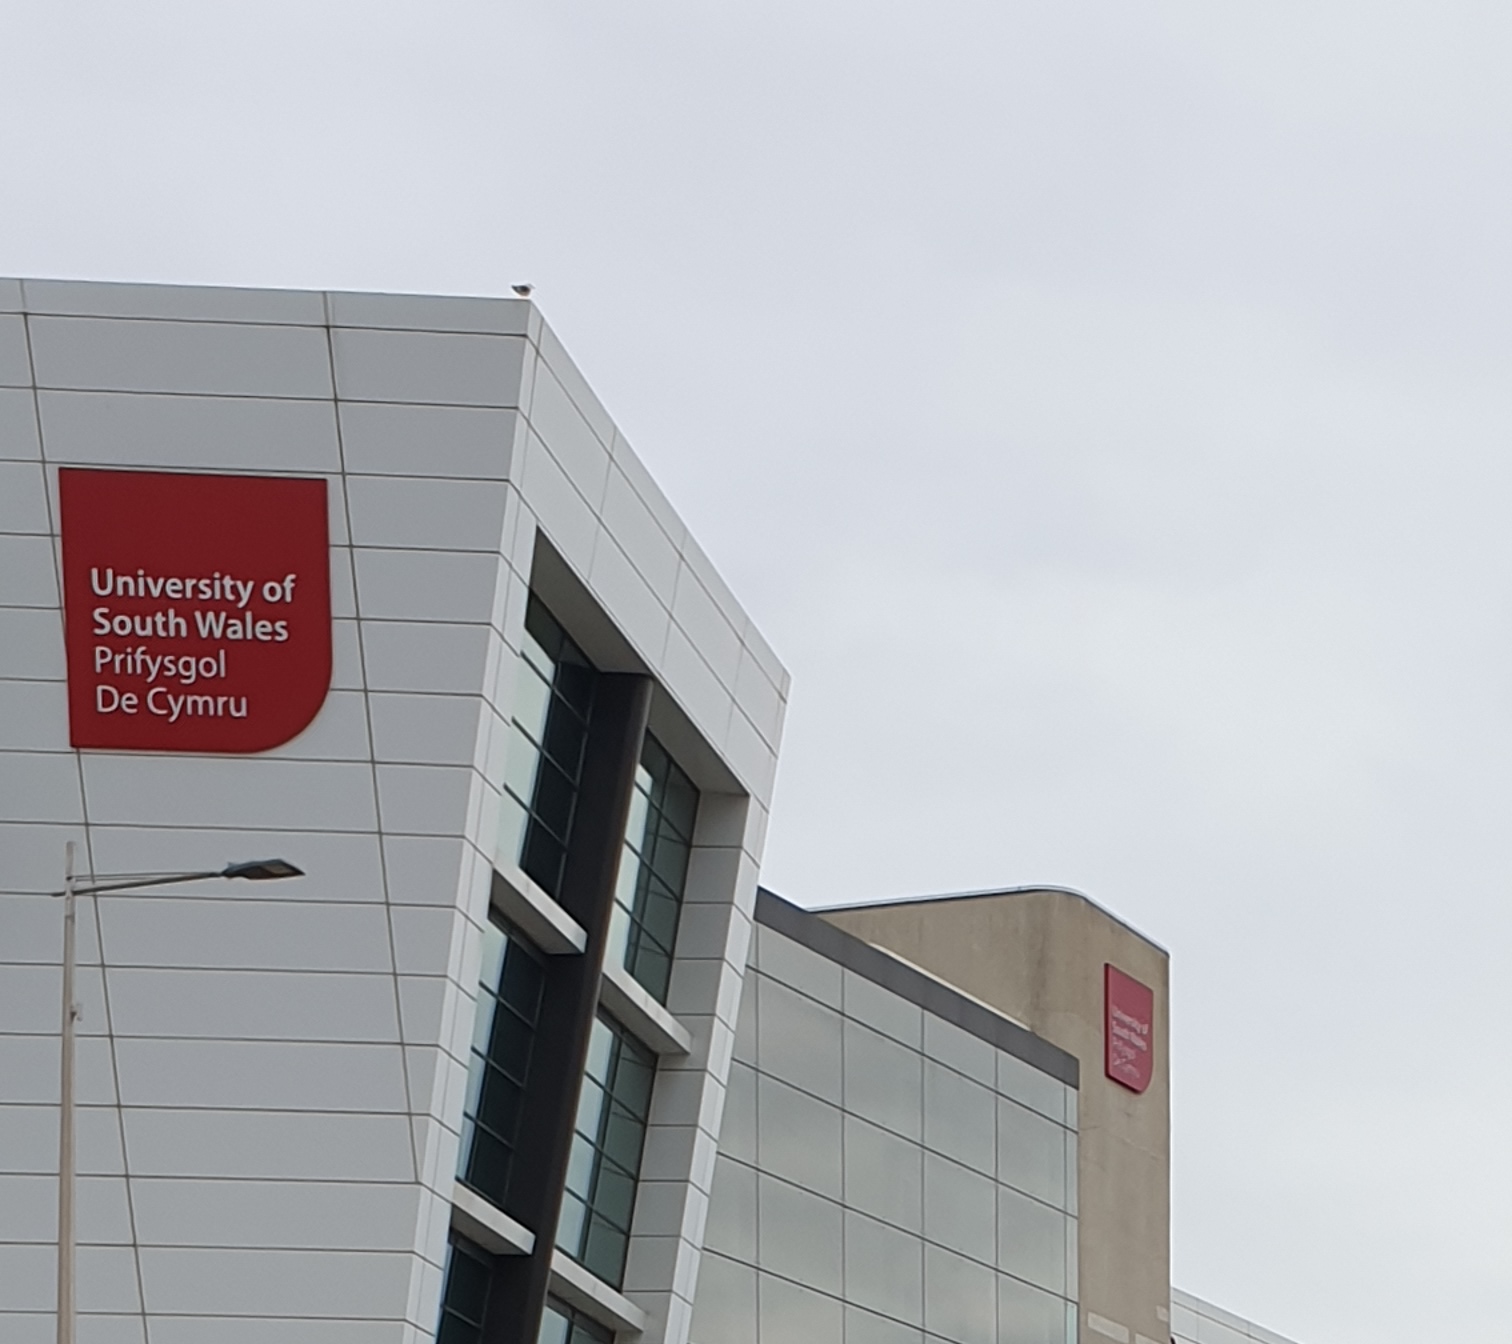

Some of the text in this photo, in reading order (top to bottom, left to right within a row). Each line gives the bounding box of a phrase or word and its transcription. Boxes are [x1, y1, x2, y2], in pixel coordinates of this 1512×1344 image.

[91, 568, 297, 609] University of
[93, 608, 289, 642] South Wales
[94, 647, 226, 684] Prifysgol
[96, 685, 247, 723] De Cymru
